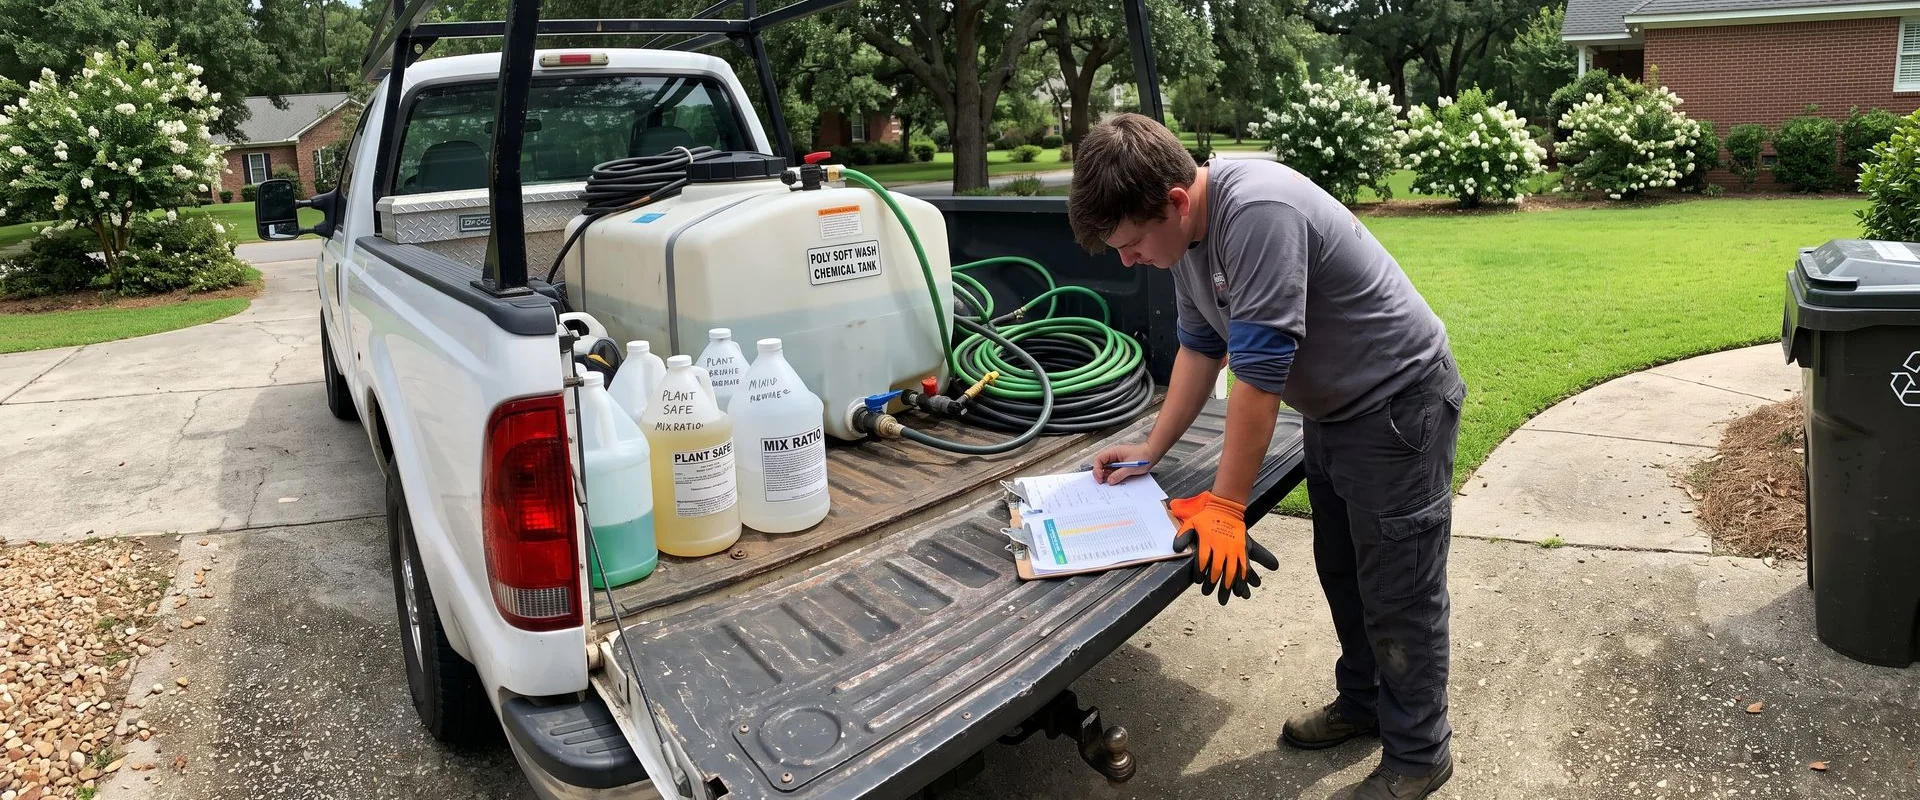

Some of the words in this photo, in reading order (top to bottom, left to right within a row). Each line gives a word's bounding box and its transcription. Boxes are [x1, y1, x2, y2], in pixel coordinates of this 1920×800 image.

[811, 251, 831, 265] POLY
[833, 248, 853, 261] SOFT
[855, 245, 877, 258] WASH
[814, 263, 856, 280] CHEMICAL
[858, 260, 877, 273] TANK
[706, 356, 735, 367] PLANT
[662, 389, 697, 402] PLANT
[663, 404, 694, 415] SAFE
[763, 438, 789, 452] MIX
[792, 428, 821, 449] RATIO
[674, 450, 710, 463] PLANT
[712, 441, 732, 458] SAFE
